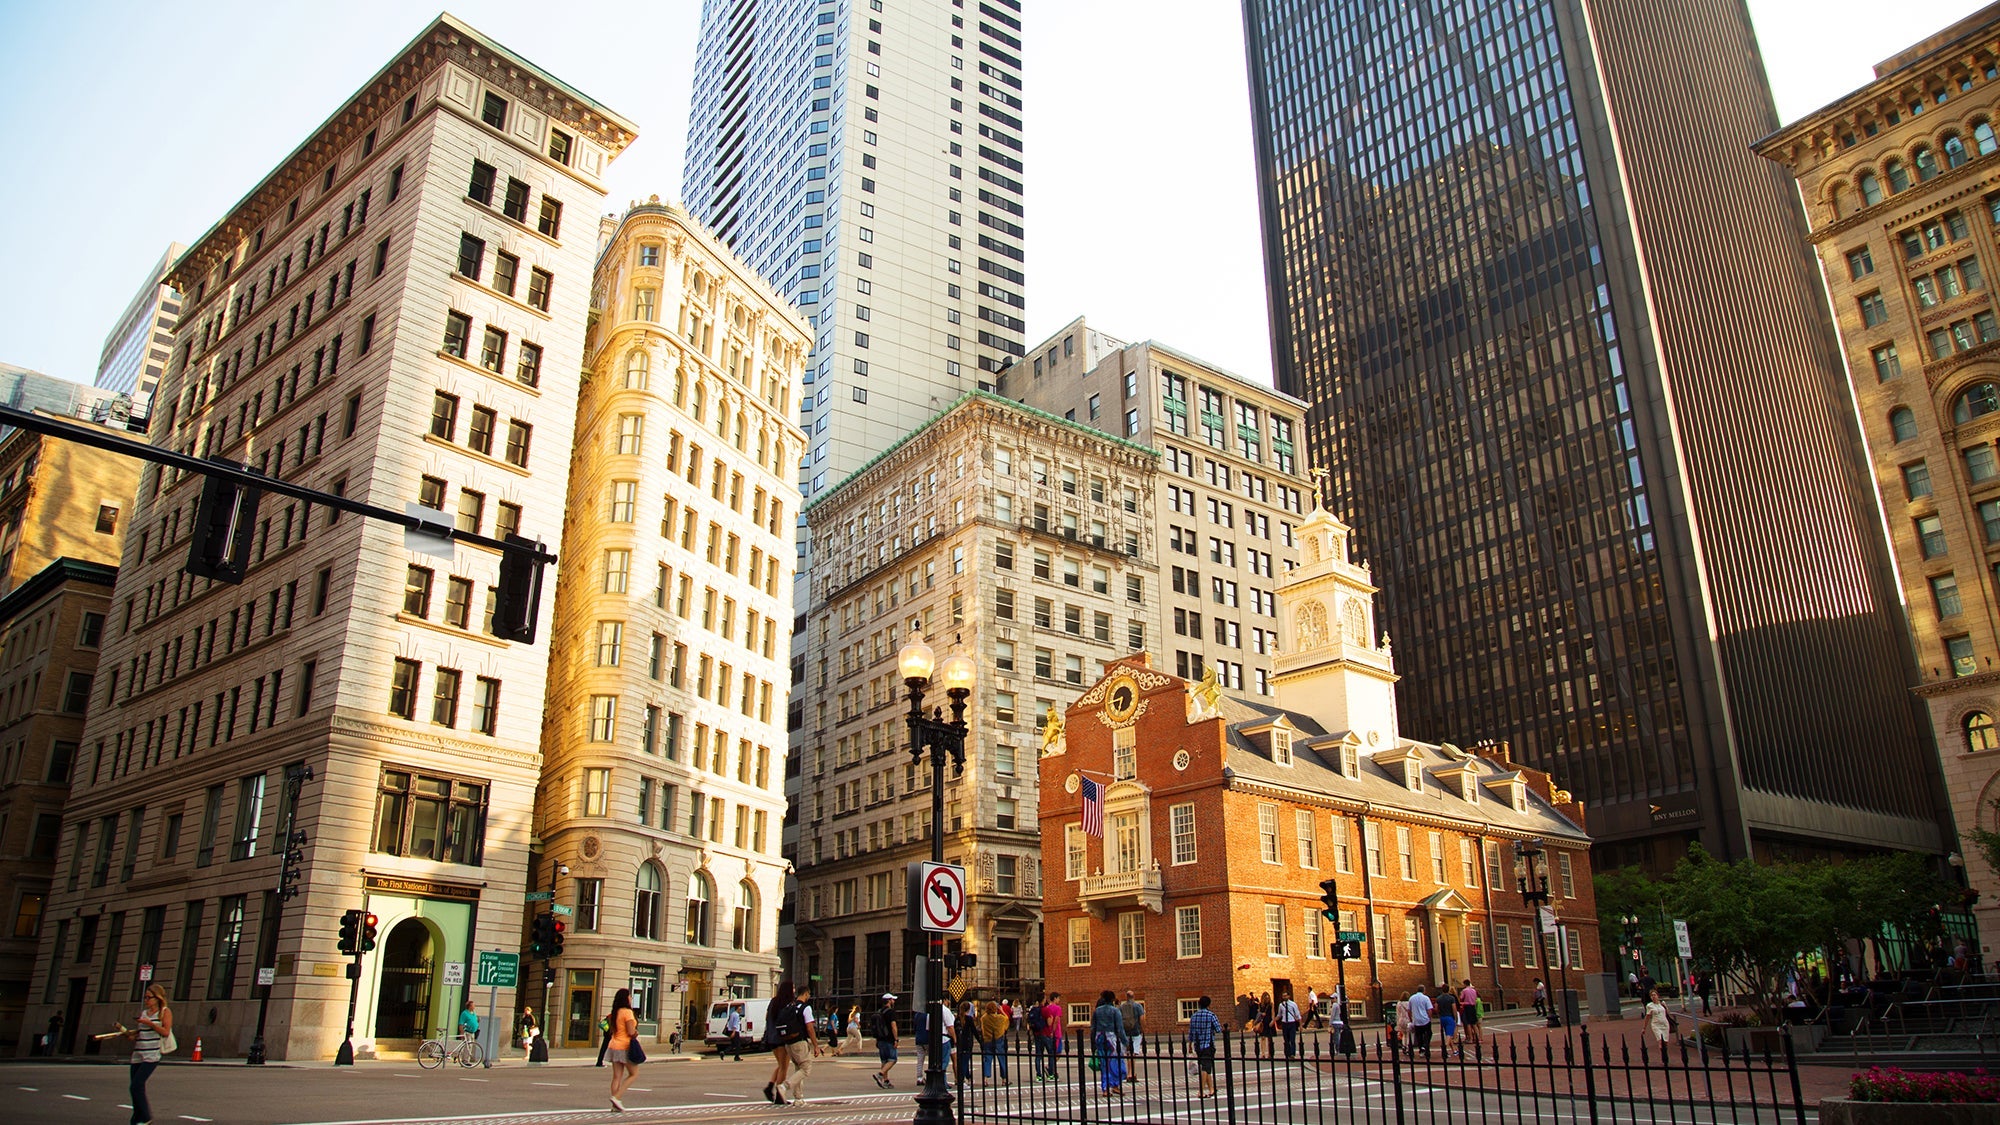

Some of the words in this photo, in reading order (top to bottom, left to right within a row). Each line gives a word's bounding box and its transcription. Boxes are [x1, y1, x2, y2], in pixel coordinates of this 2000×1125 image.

[1654, 813, 1667, 821] BNY
[1669, 808, 1696, 818] MELLON
[377, 879, 388, 888] The
[389, 880, 402, 889] First
[403, 881, 428, 892] National
[428, 883, 442, 893] Bank
[443, 886, 450, 894] of
[1346, 932, 1360, 940] STATE
